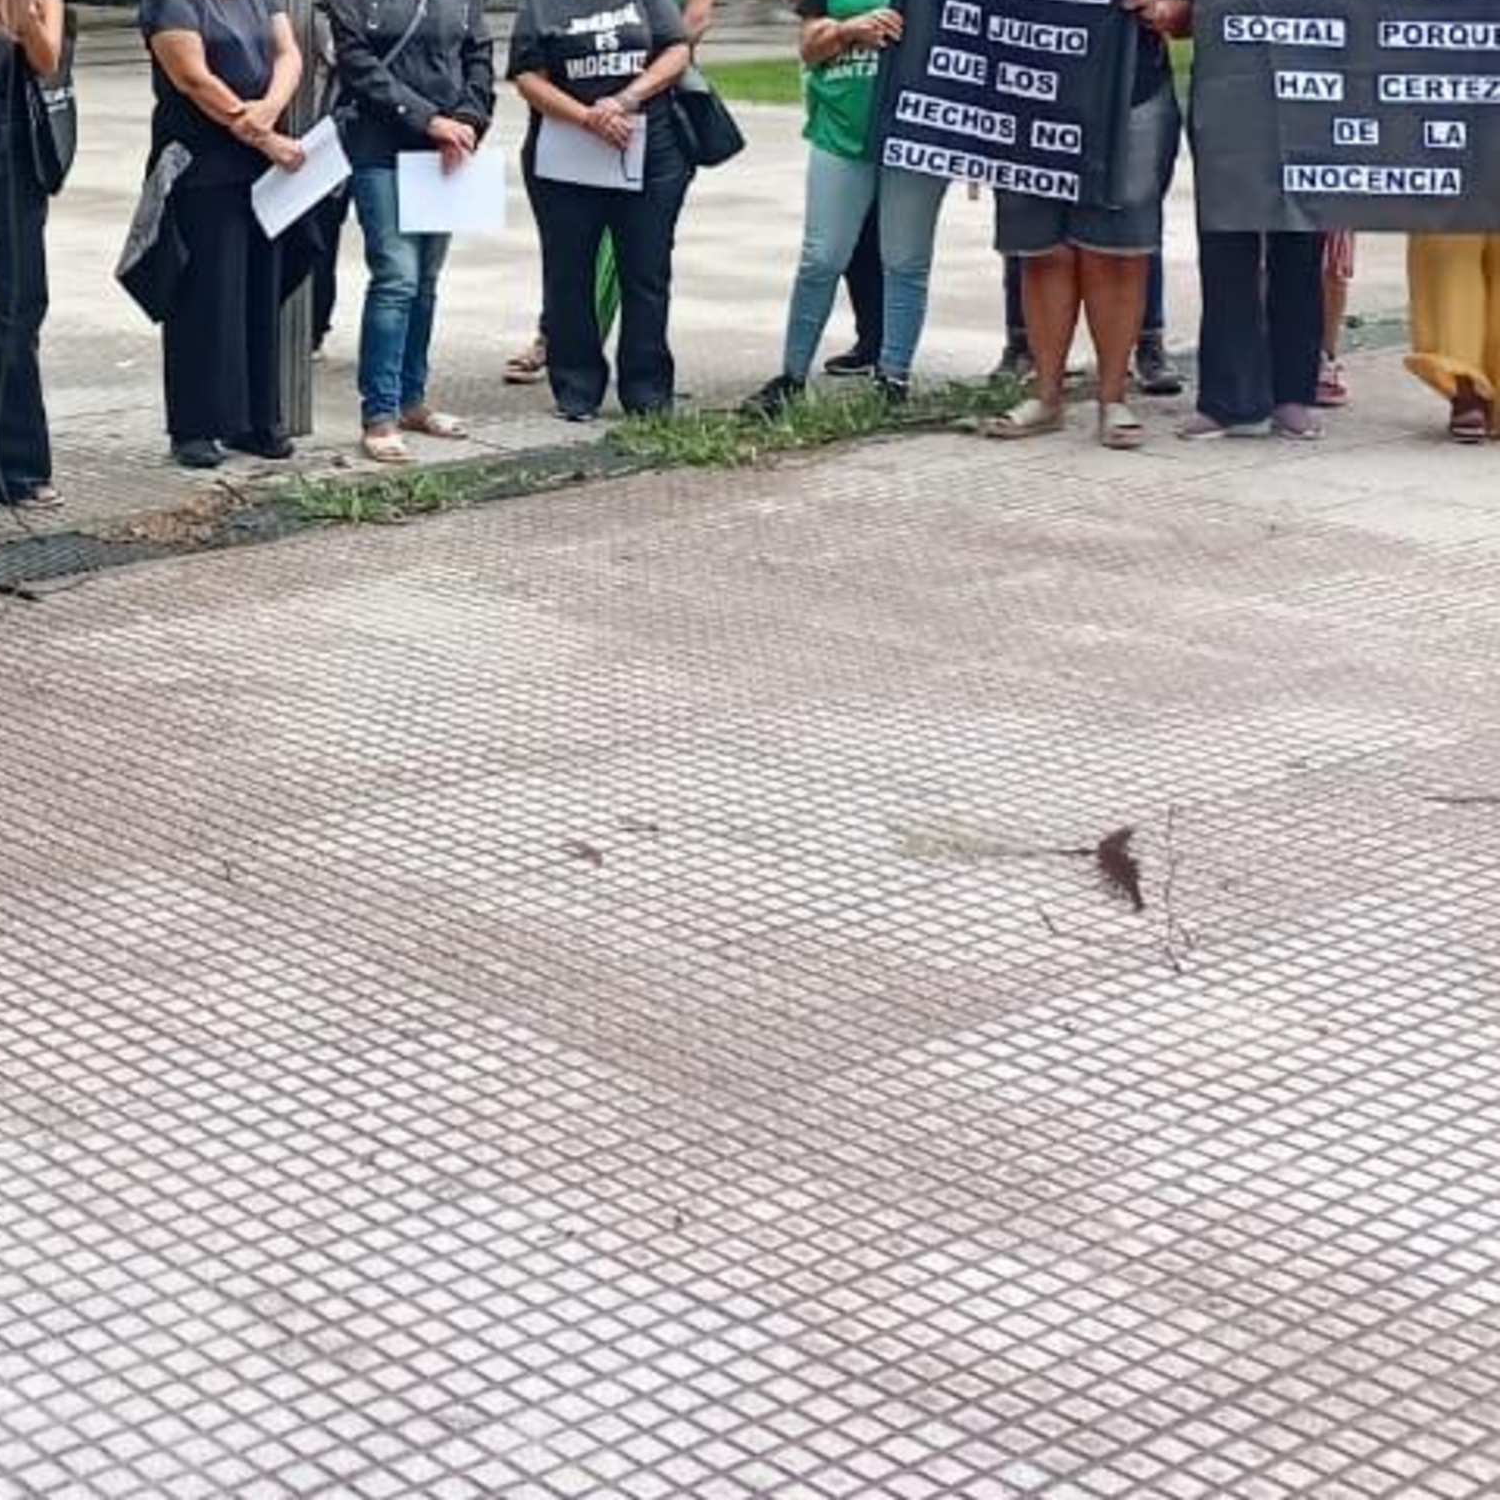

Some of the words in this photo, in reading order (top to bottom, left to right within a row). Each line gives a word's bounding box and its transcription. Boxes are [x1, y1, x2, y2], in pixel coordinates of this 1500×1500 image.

[945, 4, 979, 31] EN
[991, 20, 1086, 51] JUICIO
[1227, 17, 1342, 43] SOCIAL
[932, 51, 987, 81] QUE
[1000, 67, 1054, 95] LOS
[1279, 75, 1338, 98] HAY
[900, 95, 1014, 139] HECHOS
[1036, 125, 1080, 150] NO
[1337, 121, 1376, 142] DE
[1427, 123, 1462, 145] LA
[886, 142, 1077, 198] SUCEDIERON
[1286, 168, 1458, 192] INOCENCIA
